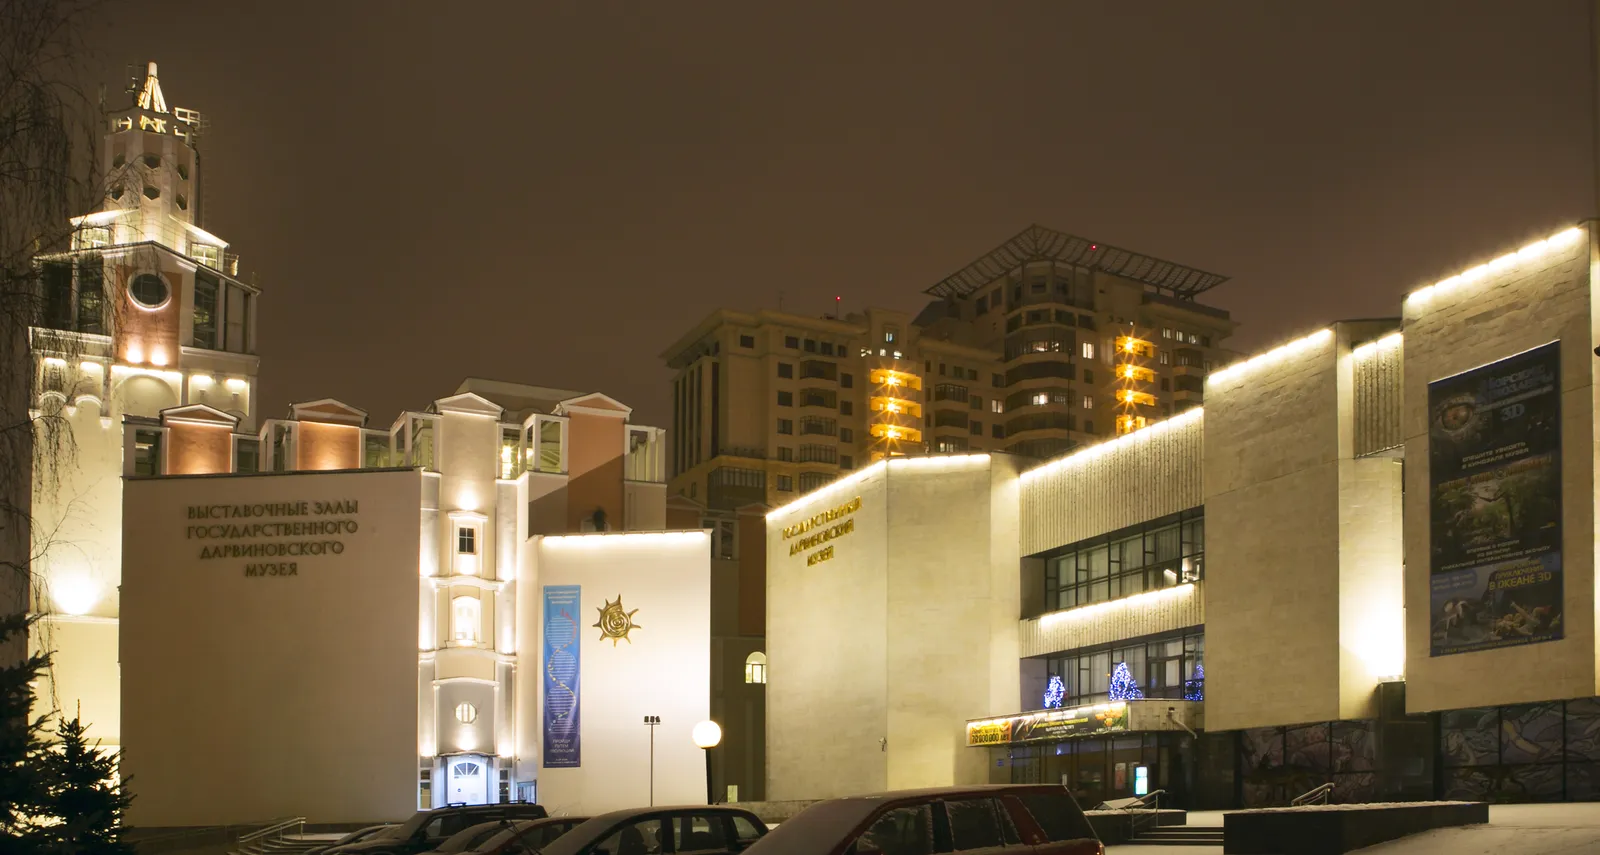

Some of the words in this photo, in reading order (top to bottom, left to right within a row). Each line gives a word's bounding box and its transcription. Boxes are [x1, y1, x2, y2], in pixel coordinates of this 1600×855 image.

[1500, 403, 1525, 421] 3D
[1462, 449, 1493, 463] СПЕШИТЕ
[1467, 454, 1504, 468] КИНОЗАЛЕ
[1504, 447, 1530, 459] МУЗЕЯ
[187, 501, 309, 520] ВЫСТАВОЧНЫЕ
[313, 499, 359, 516] ЗАЛЫ
[187, 520, 359, 540] ГОСУДАРСТВЕННОГО
[199, 541, 345, 560] ДАРВИНОВСКОГО
[244, 562, 298, 578] МУЗЕЯ
[1489, 581, 1495, 591] В
[1498, 573, 1535, 589] ОКЕАНЕ
[1537, 571, 1552, 582] 3D
